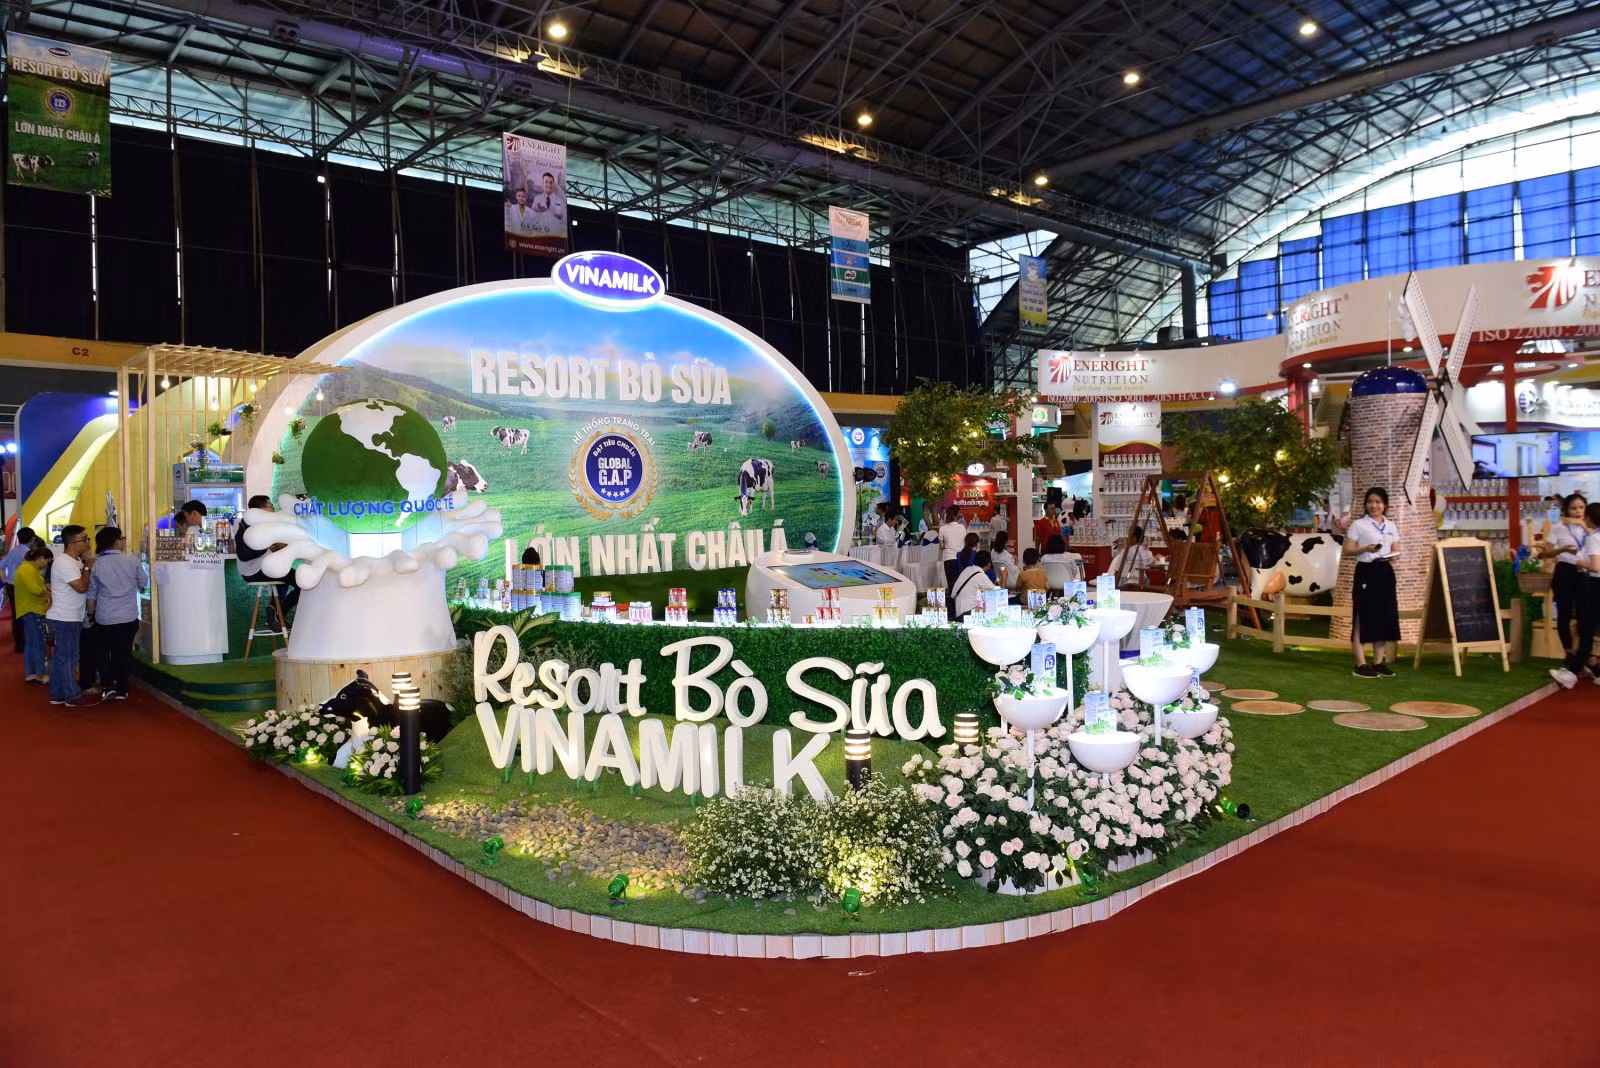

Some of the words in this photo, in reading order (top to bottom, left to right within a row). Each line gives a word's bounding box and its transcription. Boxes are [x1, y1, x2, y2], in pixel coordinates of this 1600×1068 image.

[12, 57, 58, 78] RESORT
[62, 64, 78, 81] BÒ
[81, 67, 106, 86] SỮA
[15, 120, 34, 134] LỚN
[38, 122, 64, 139] NHẤT
[66, 128, 92, 144] CHÂU
[94, 133, 100, 144] Á
[522, 141, 562, 154] ENERIGHT
[518, 241, 566, 254] www.eneright.vn
[566, 263, 656, 294] VINAMILK
[1479, 329, 1510, 342] ISO
[1514, 327, 1562, 339] 22000
[71, 346, 90, 357] C2
[1074, 360, 1149, 372] ENERIGHT
[469, 350, 611, 400] RESORT
[618, 352, 662, 403] BÒ
[671, 357, 733, 406] SỮA
[1074, 374, 1149, 384] NUTRITION
[572, 431, 584, 445] HỆ
[583, 416, 610, 434] THỐNG
[612, 416, 640, 432] TRANG
[640, 428, 656, 447] TRẠI
[592, 444, 604, 457] ĐẠT
[603, 438, 616, 447] TIÊU
[616, 440, 636, 458] CHUẨN
[598, 457, 632, 470] GLOBAL
[598, 470, 632, 486] G.A.P
[293, 496, 323, 516] CHẤT
[328, 501, 394, 519] LƯỢNG
[400, 494, 442, 512] QUỐC
[443, 492, 454, 510] TẾ
[590, 518, 676, 576] NHẤT
[686, 521, 764, 572] CHÂU
[474, 624, 647, 718] Resort
[660, 636, 768, 728] Bò
[786, 656, 947, 741] Sữa
[476, 701, 835, 802] VINAMILK
